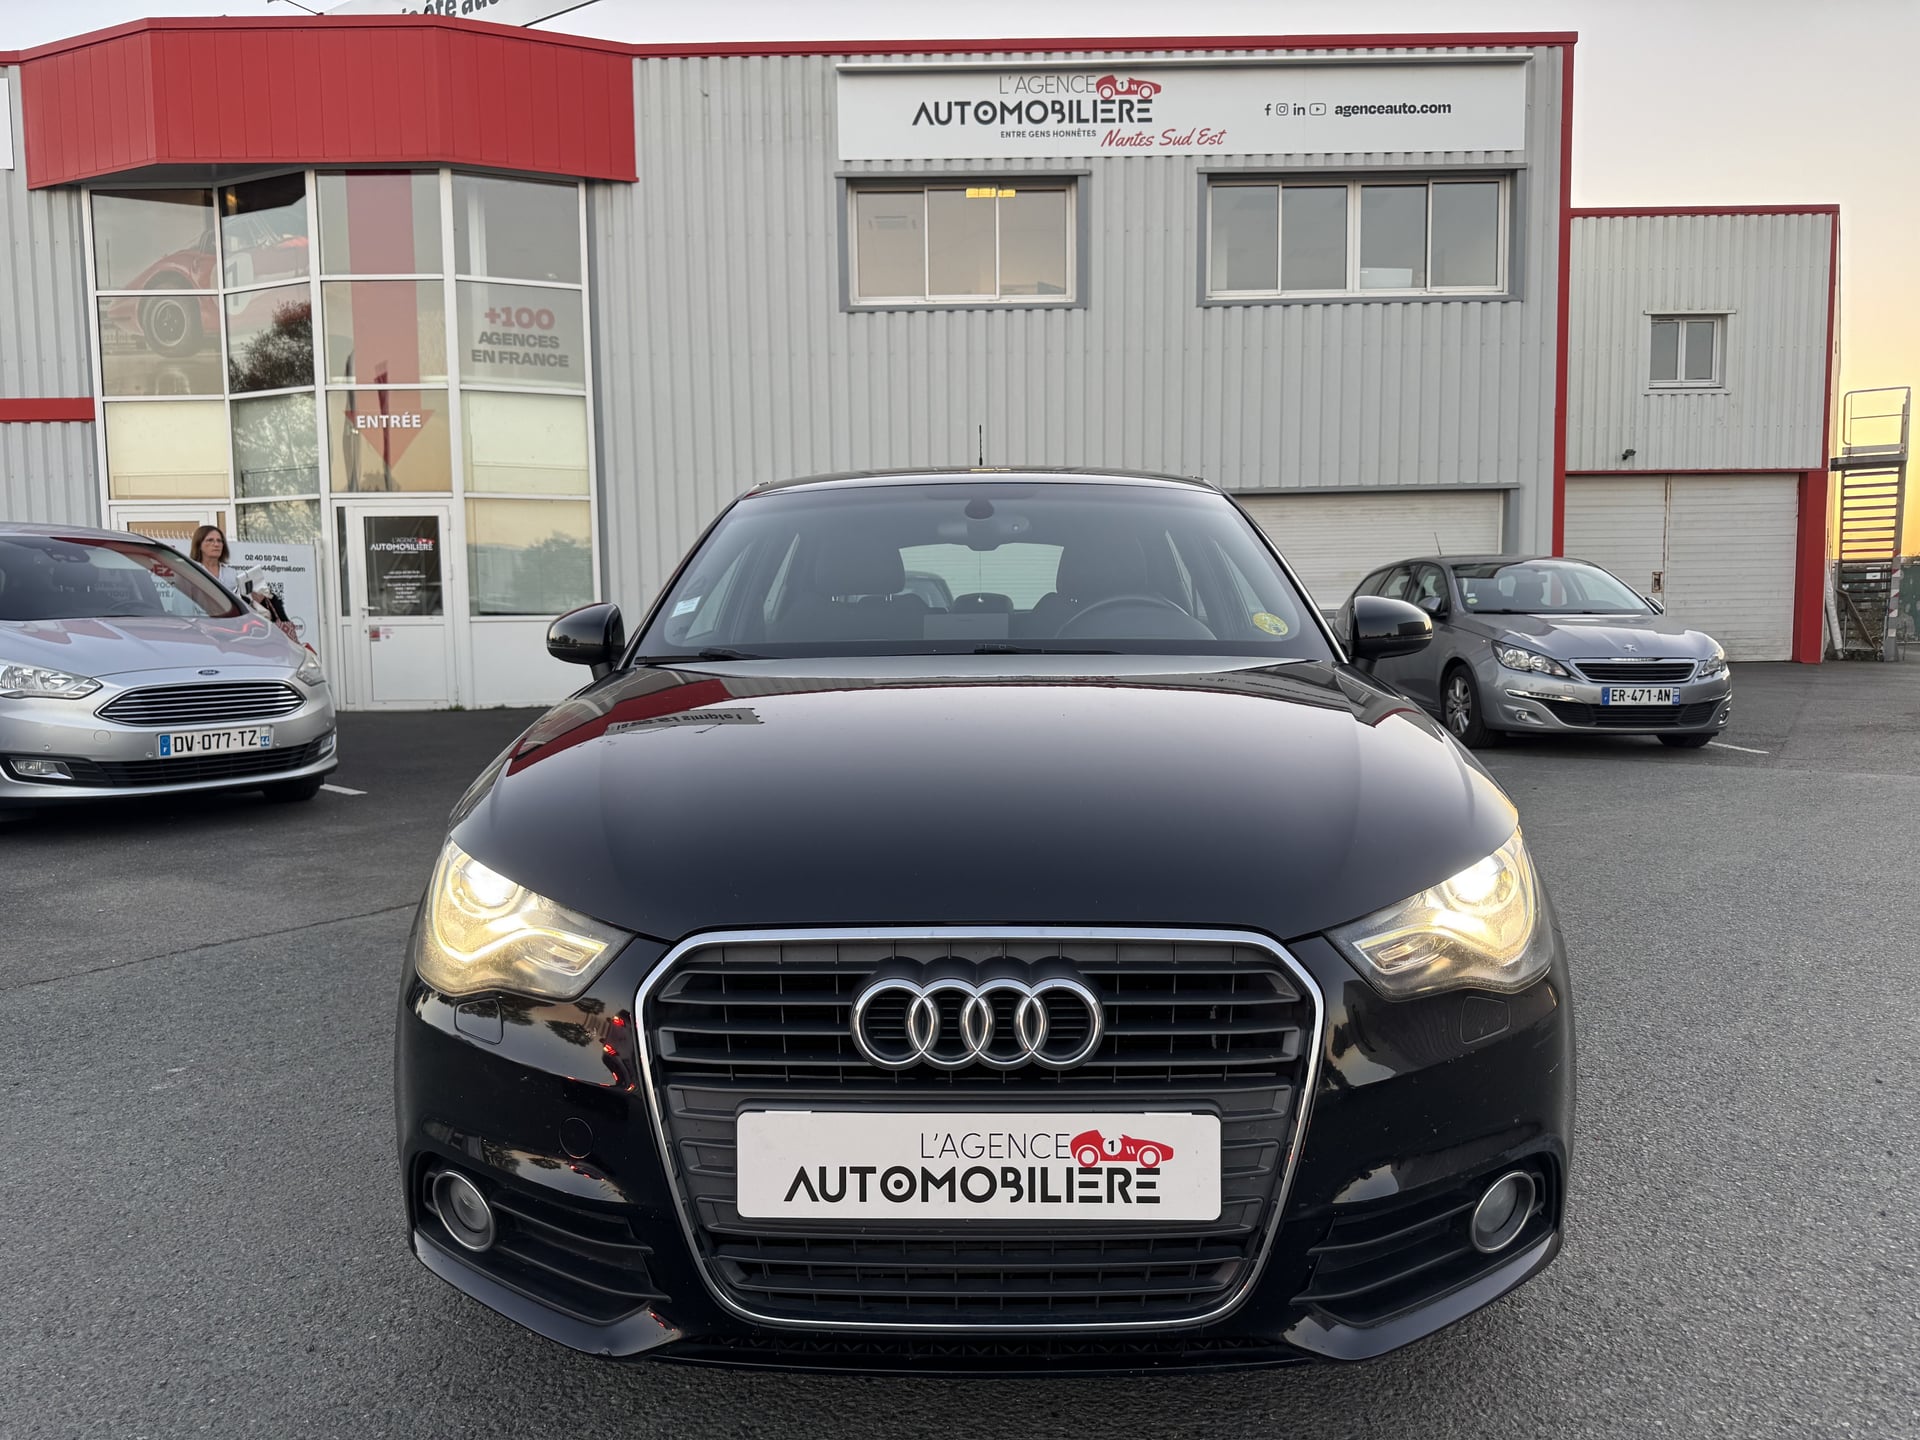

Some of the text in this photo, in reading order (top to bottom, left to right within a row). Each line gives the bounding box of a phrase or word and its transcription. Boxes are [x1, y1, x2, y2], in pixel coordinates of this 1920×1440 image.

[999, 74, 1096, 95] L'AGENCE
[1334, 103, 1452, 117] agenceauto.com
[1000, 128, 1097, 138] ENTRE GENS HONNÊTES
[1100, 127, 1227, 148] Nantes Sud Est
[484, 306, 556, 330] +100
[478, 331, 560, 349] AGENCES
[471, 349, 569, 367] EN FRANCE
[356, 411, 422, 429] ENTRÉE
[1611, 689, 1671, 702] ER-471-AN
[173, 730, 258, 753] DV-077-TZ
[920, 1132, 1071, 1160] L'AGENCE
